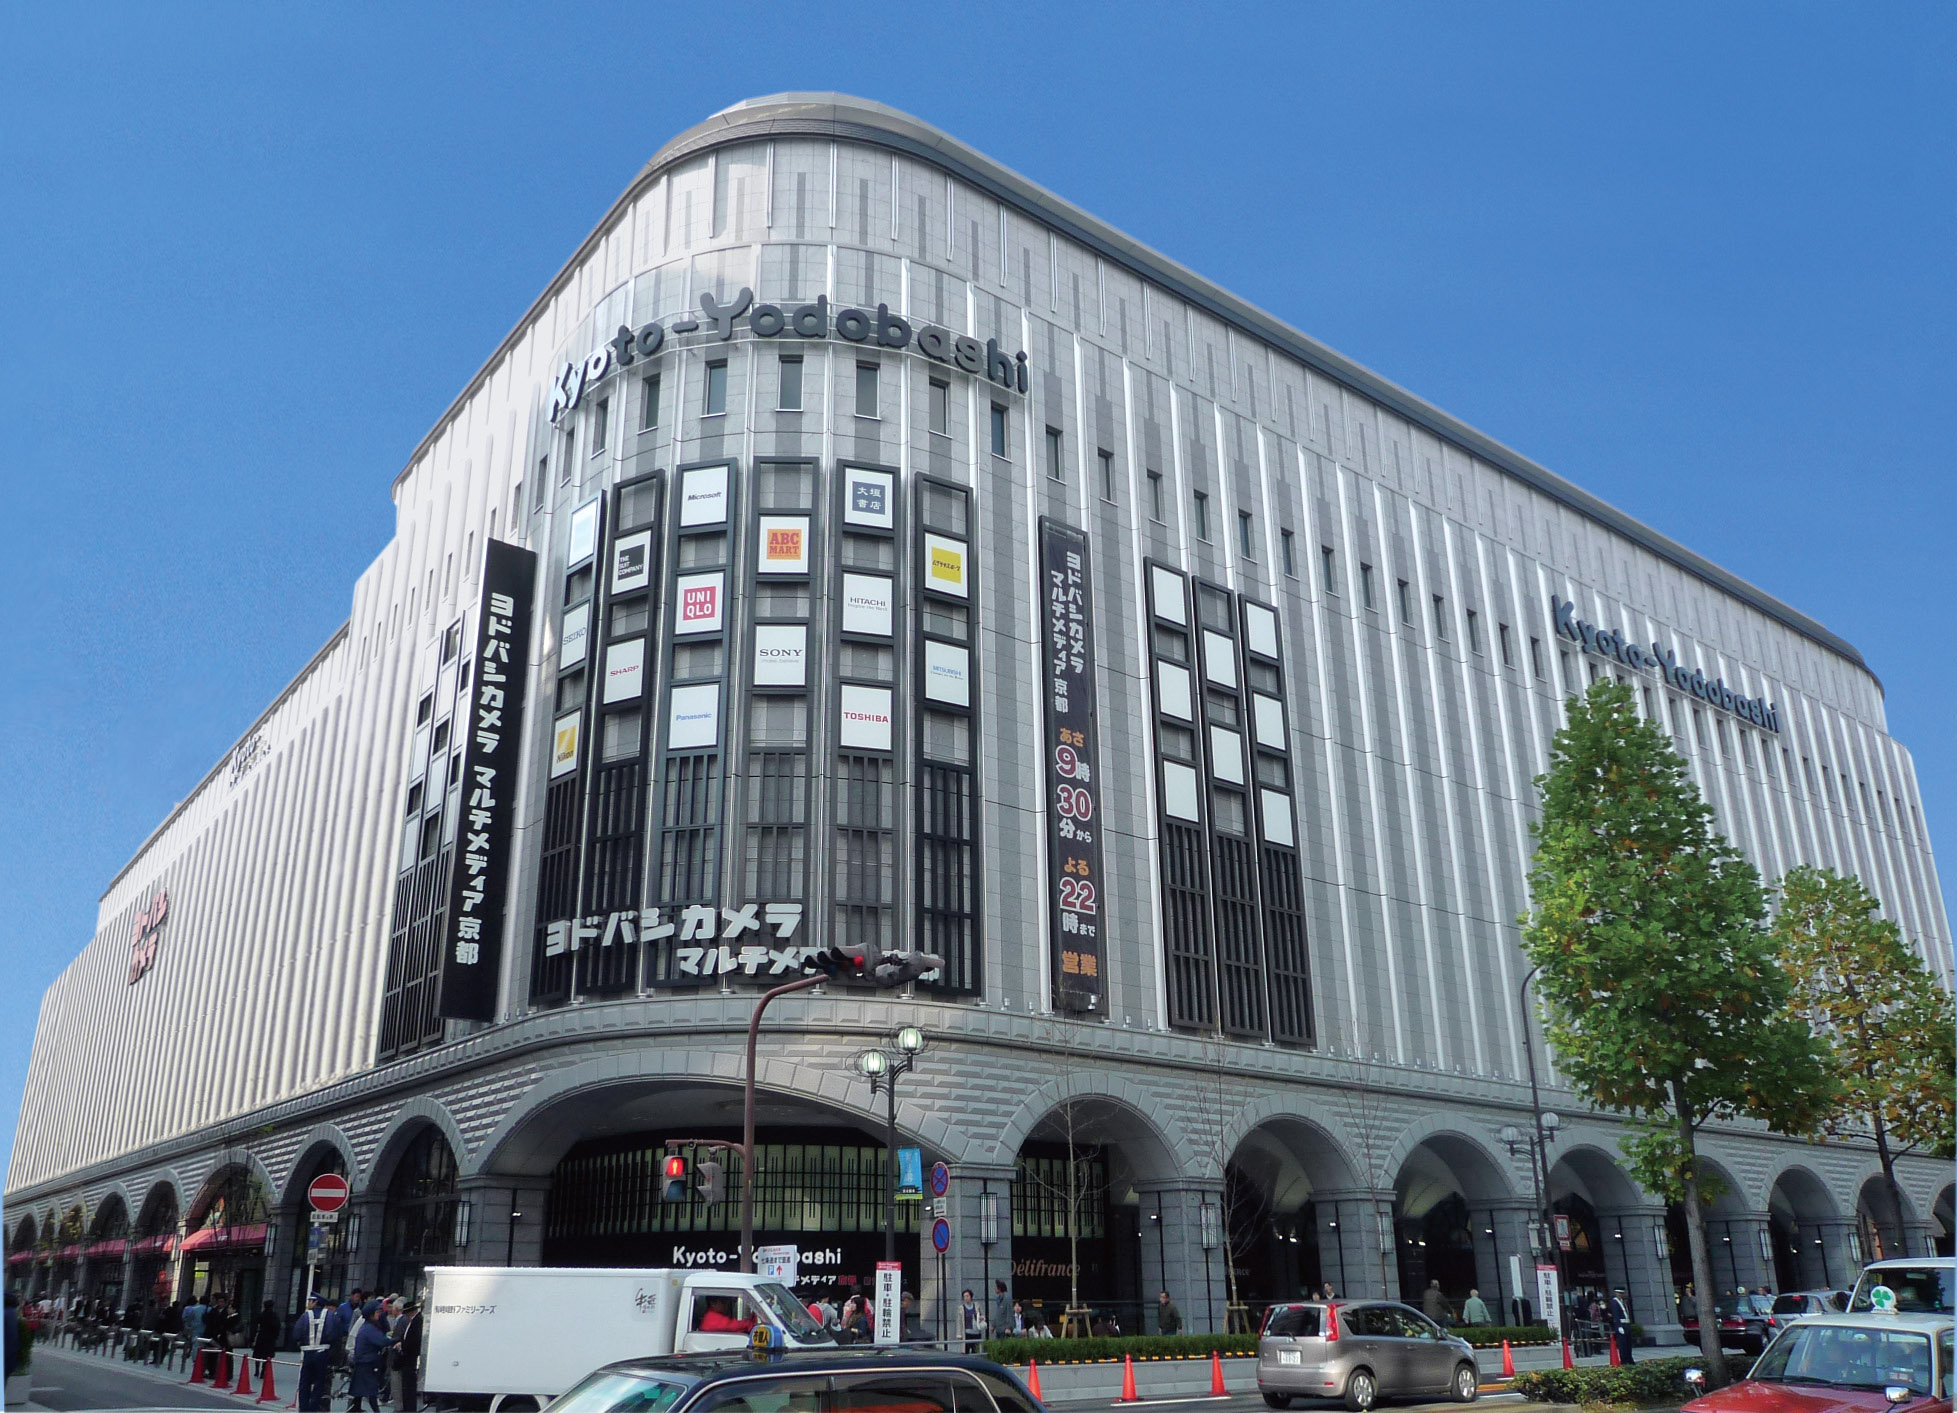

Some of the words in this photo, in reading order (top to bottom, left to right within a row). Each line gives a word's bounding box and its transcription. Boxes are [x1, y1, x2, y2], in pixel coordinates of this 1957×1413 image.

[550, 287, 1028, 422] Kyoto-Yodobashi
[687, 491, 722, 501] Microsoft
[857, 486, 882, 498] 大垣
[856, 499, 881, 510] 書店
[770, 532, 799, 545] ABC
[769, 546, 799, 554] MART
[618, 564, 643, 576] COMPANY
[687, 590, 711, 603] UNI
[850, 597, 886, 607] HITACHI
[686, 604, 712, 617] QLO
[1066, 551, 1084, 674] ヨドバシカメラ
[562, 627, 587, 646] SEIKO
[759, 649, 802, 657] SONY
[1551, 594, 1780, 733] Kyoto-Yodobashi
[476, 592, 514, 754] ヨドバシカメラ
[610, 664, 639, 677] SHARP
[676, 712, 712, 721] Panasonic
[844, 711, 889, 723] TOSHIBA
[1060, 728, 1084, 747] あさ
[556, 750, 574, 763] Nikon
[1064, 857, 1089, 876] よる
[546, 904, 802, 957] ヨドバシカメラ
[1062, 950, 1097, 977] 営業
